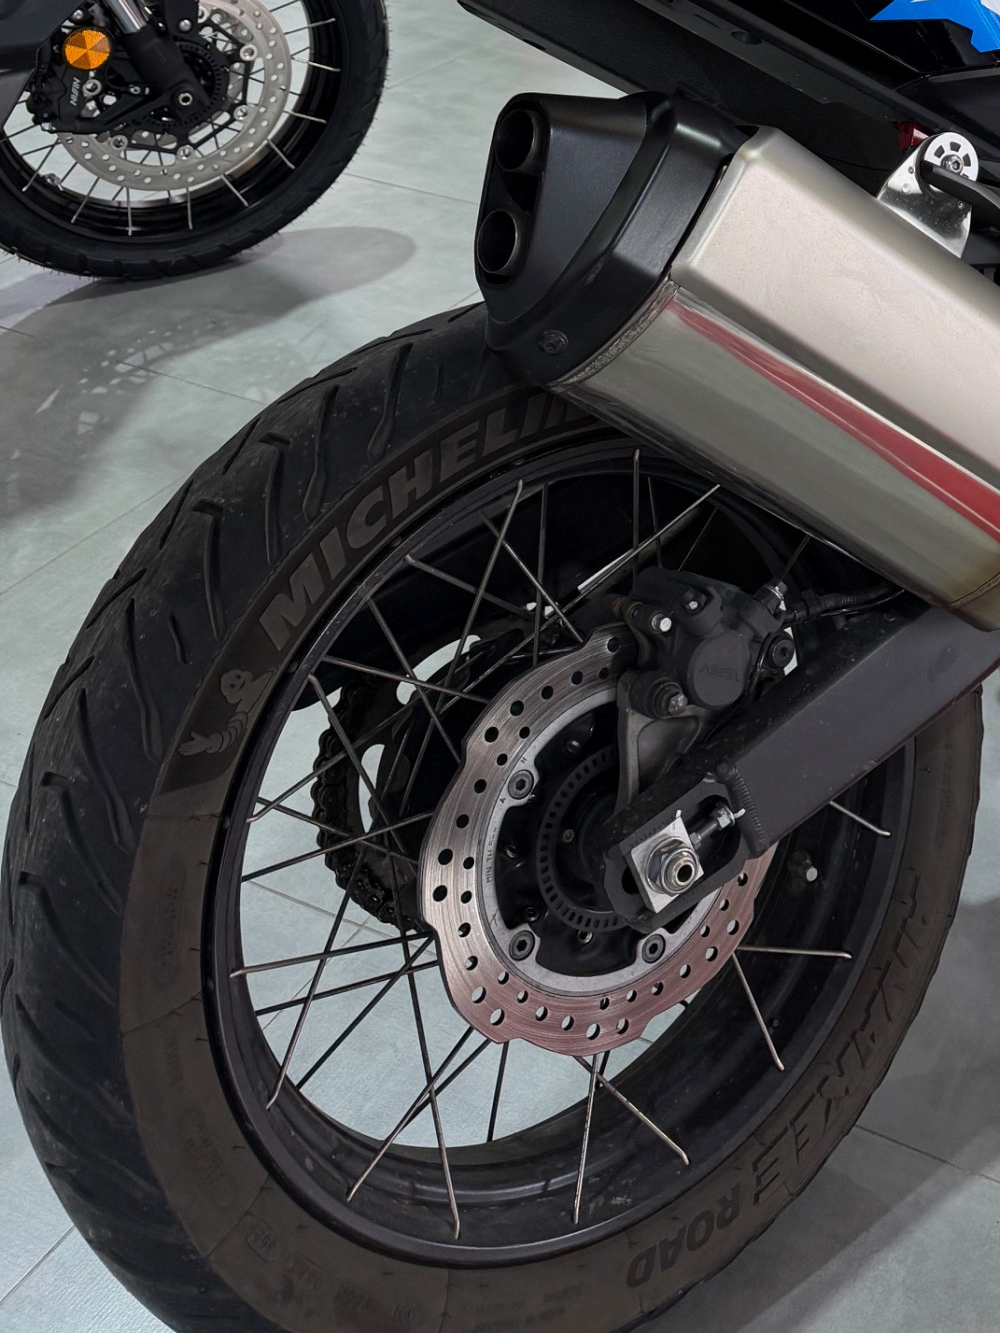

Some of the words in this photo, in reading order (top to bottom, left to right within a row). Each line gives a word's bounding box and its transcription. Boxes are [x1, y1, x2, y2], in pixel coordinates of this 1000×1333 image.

[485, 866, 493, 884] MIN
[750, 861, 948, 1208] ANAKEE
[625, 1181, 742, 1289] ROAD
